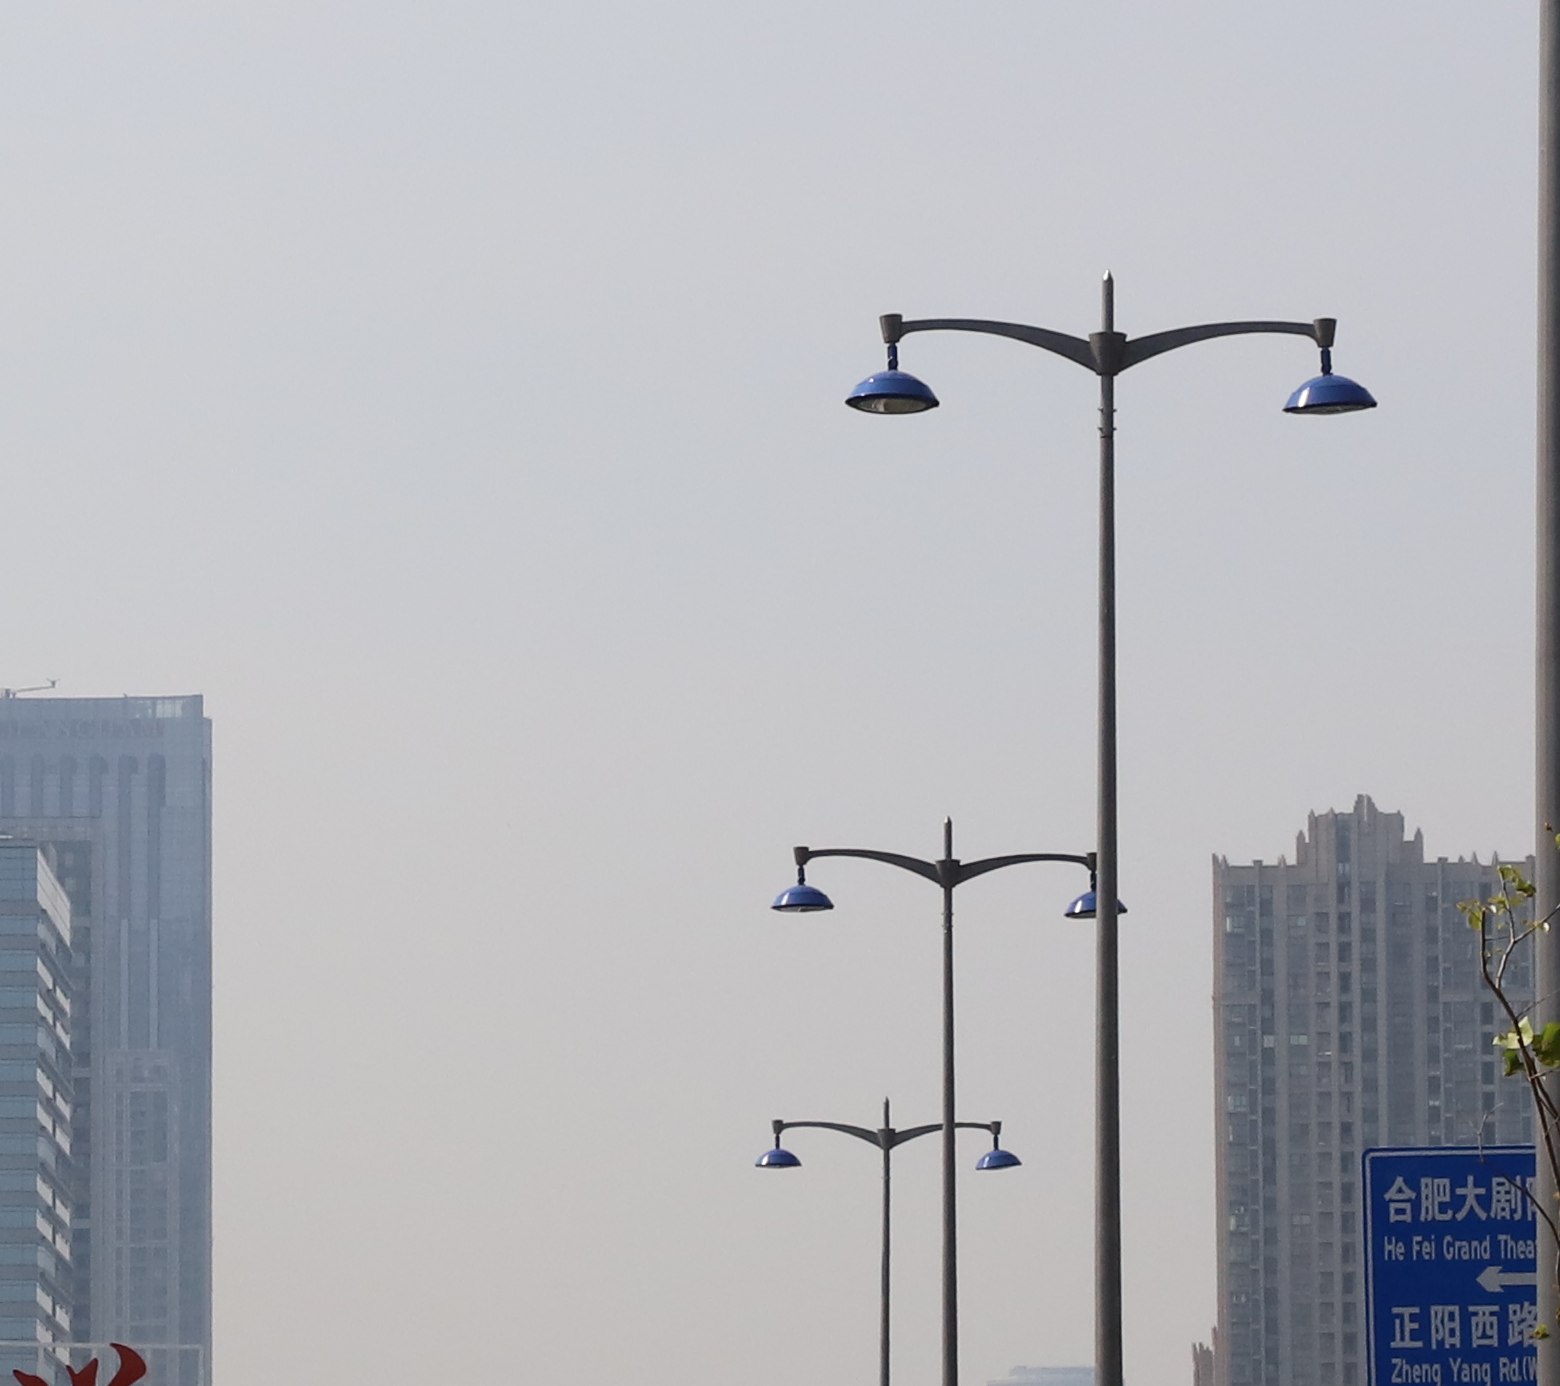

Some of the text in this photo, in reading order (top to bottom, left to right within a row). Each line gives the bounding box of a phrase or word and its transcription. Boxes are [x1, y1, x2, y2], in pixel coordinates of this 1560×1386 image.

[1384, 1233, 1537, 1261] He Fei Grand Thea
[1390, 1301, 1537, 1350] 正阳西路
